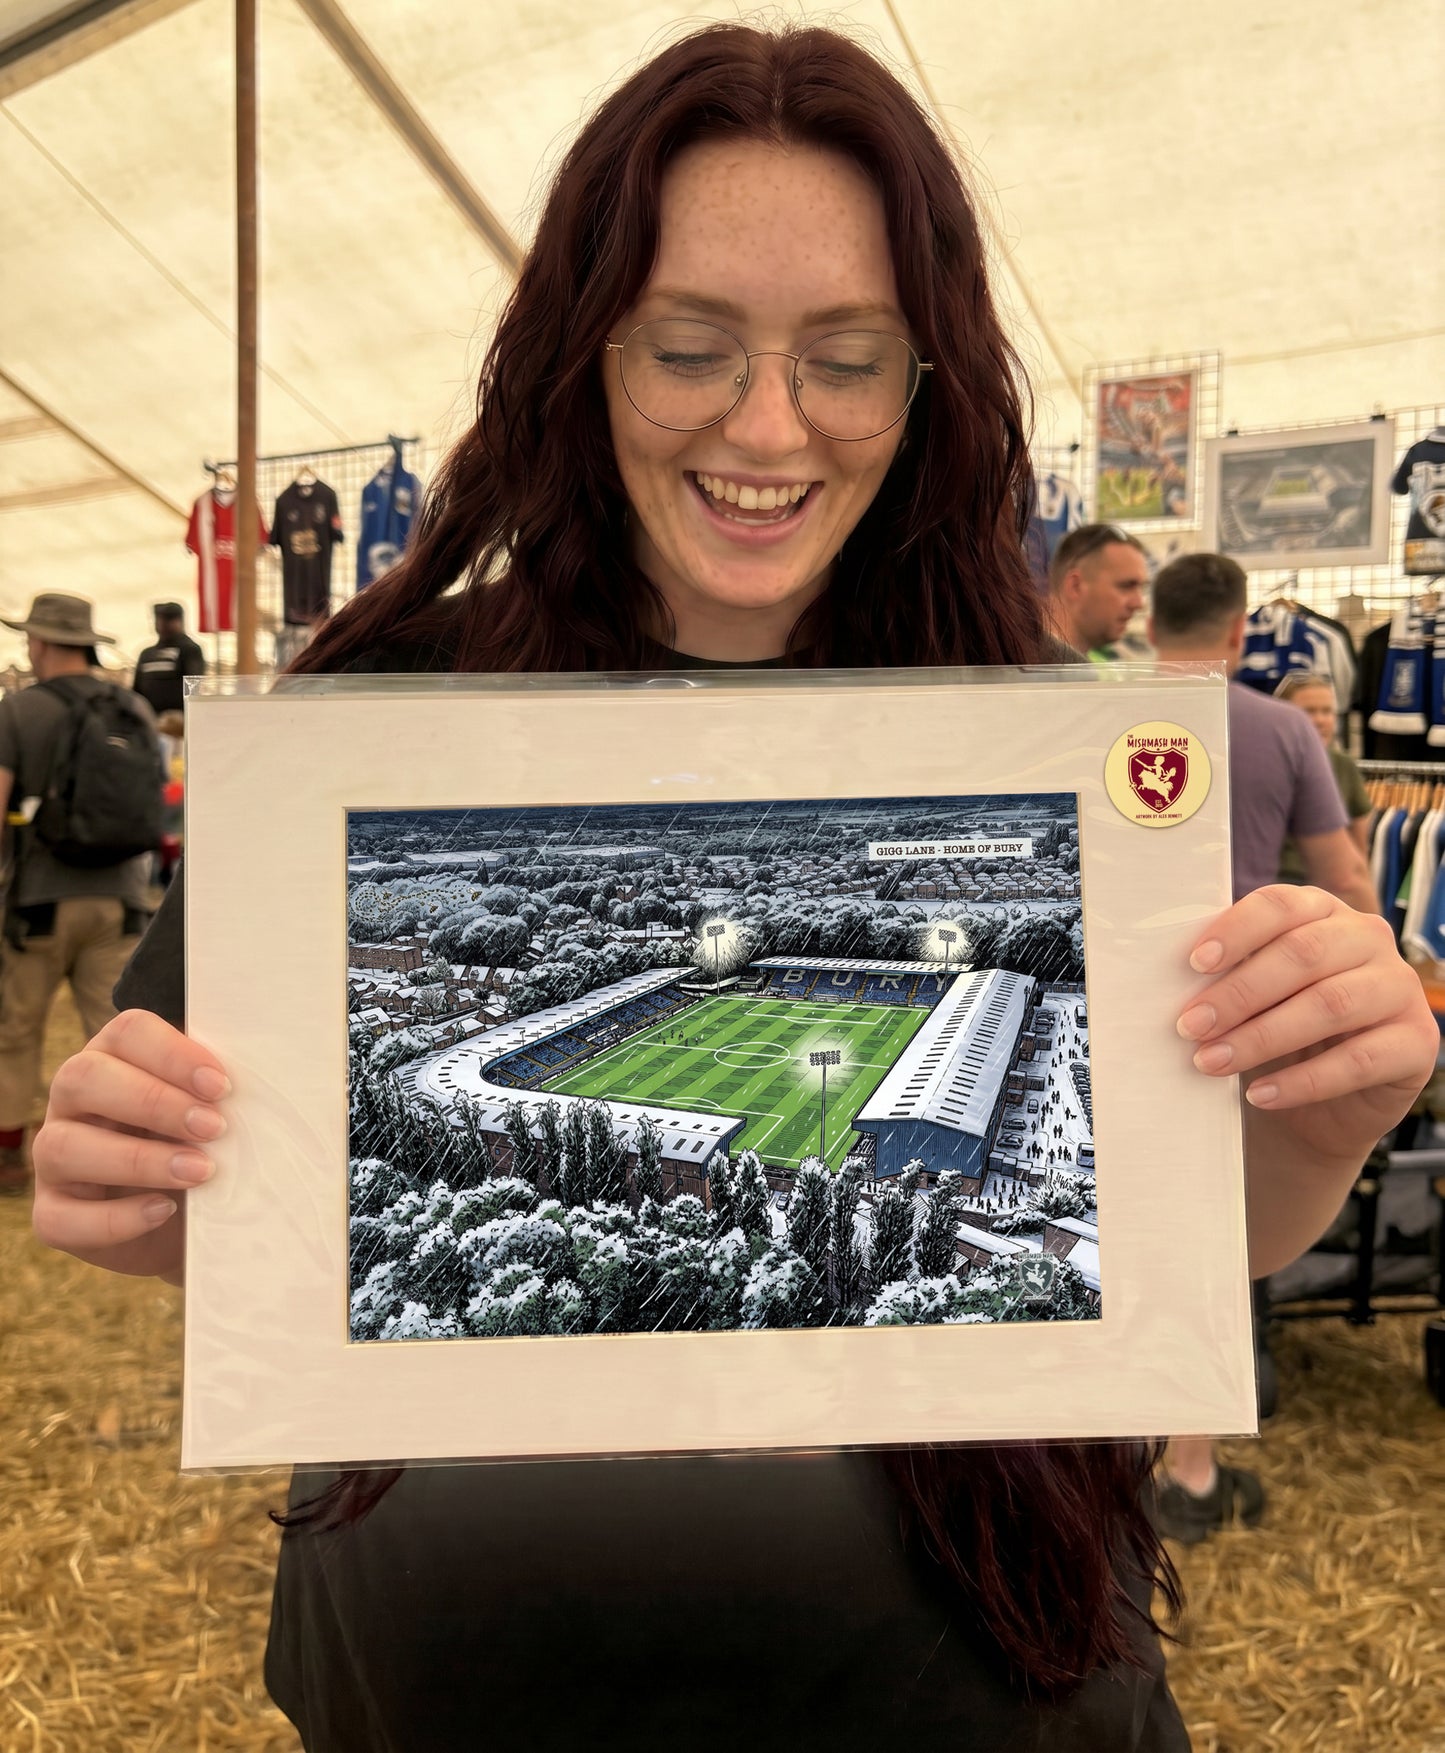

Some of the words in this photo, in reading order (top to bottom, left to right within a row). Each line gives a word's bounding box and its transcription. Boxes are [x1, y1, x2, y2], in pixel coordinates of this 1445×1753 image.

[1127, 738, 1168, 748] MISHMASH
[1170, 737, 1188, 747] MAN
[876, 846, 903, 856] GIGG
[905, 846, 935, 855] LANE
[943, 845, 975, 854] HOME
[977, 844, 991, 853] OF
[993, 843, 1023, 853] BURY
